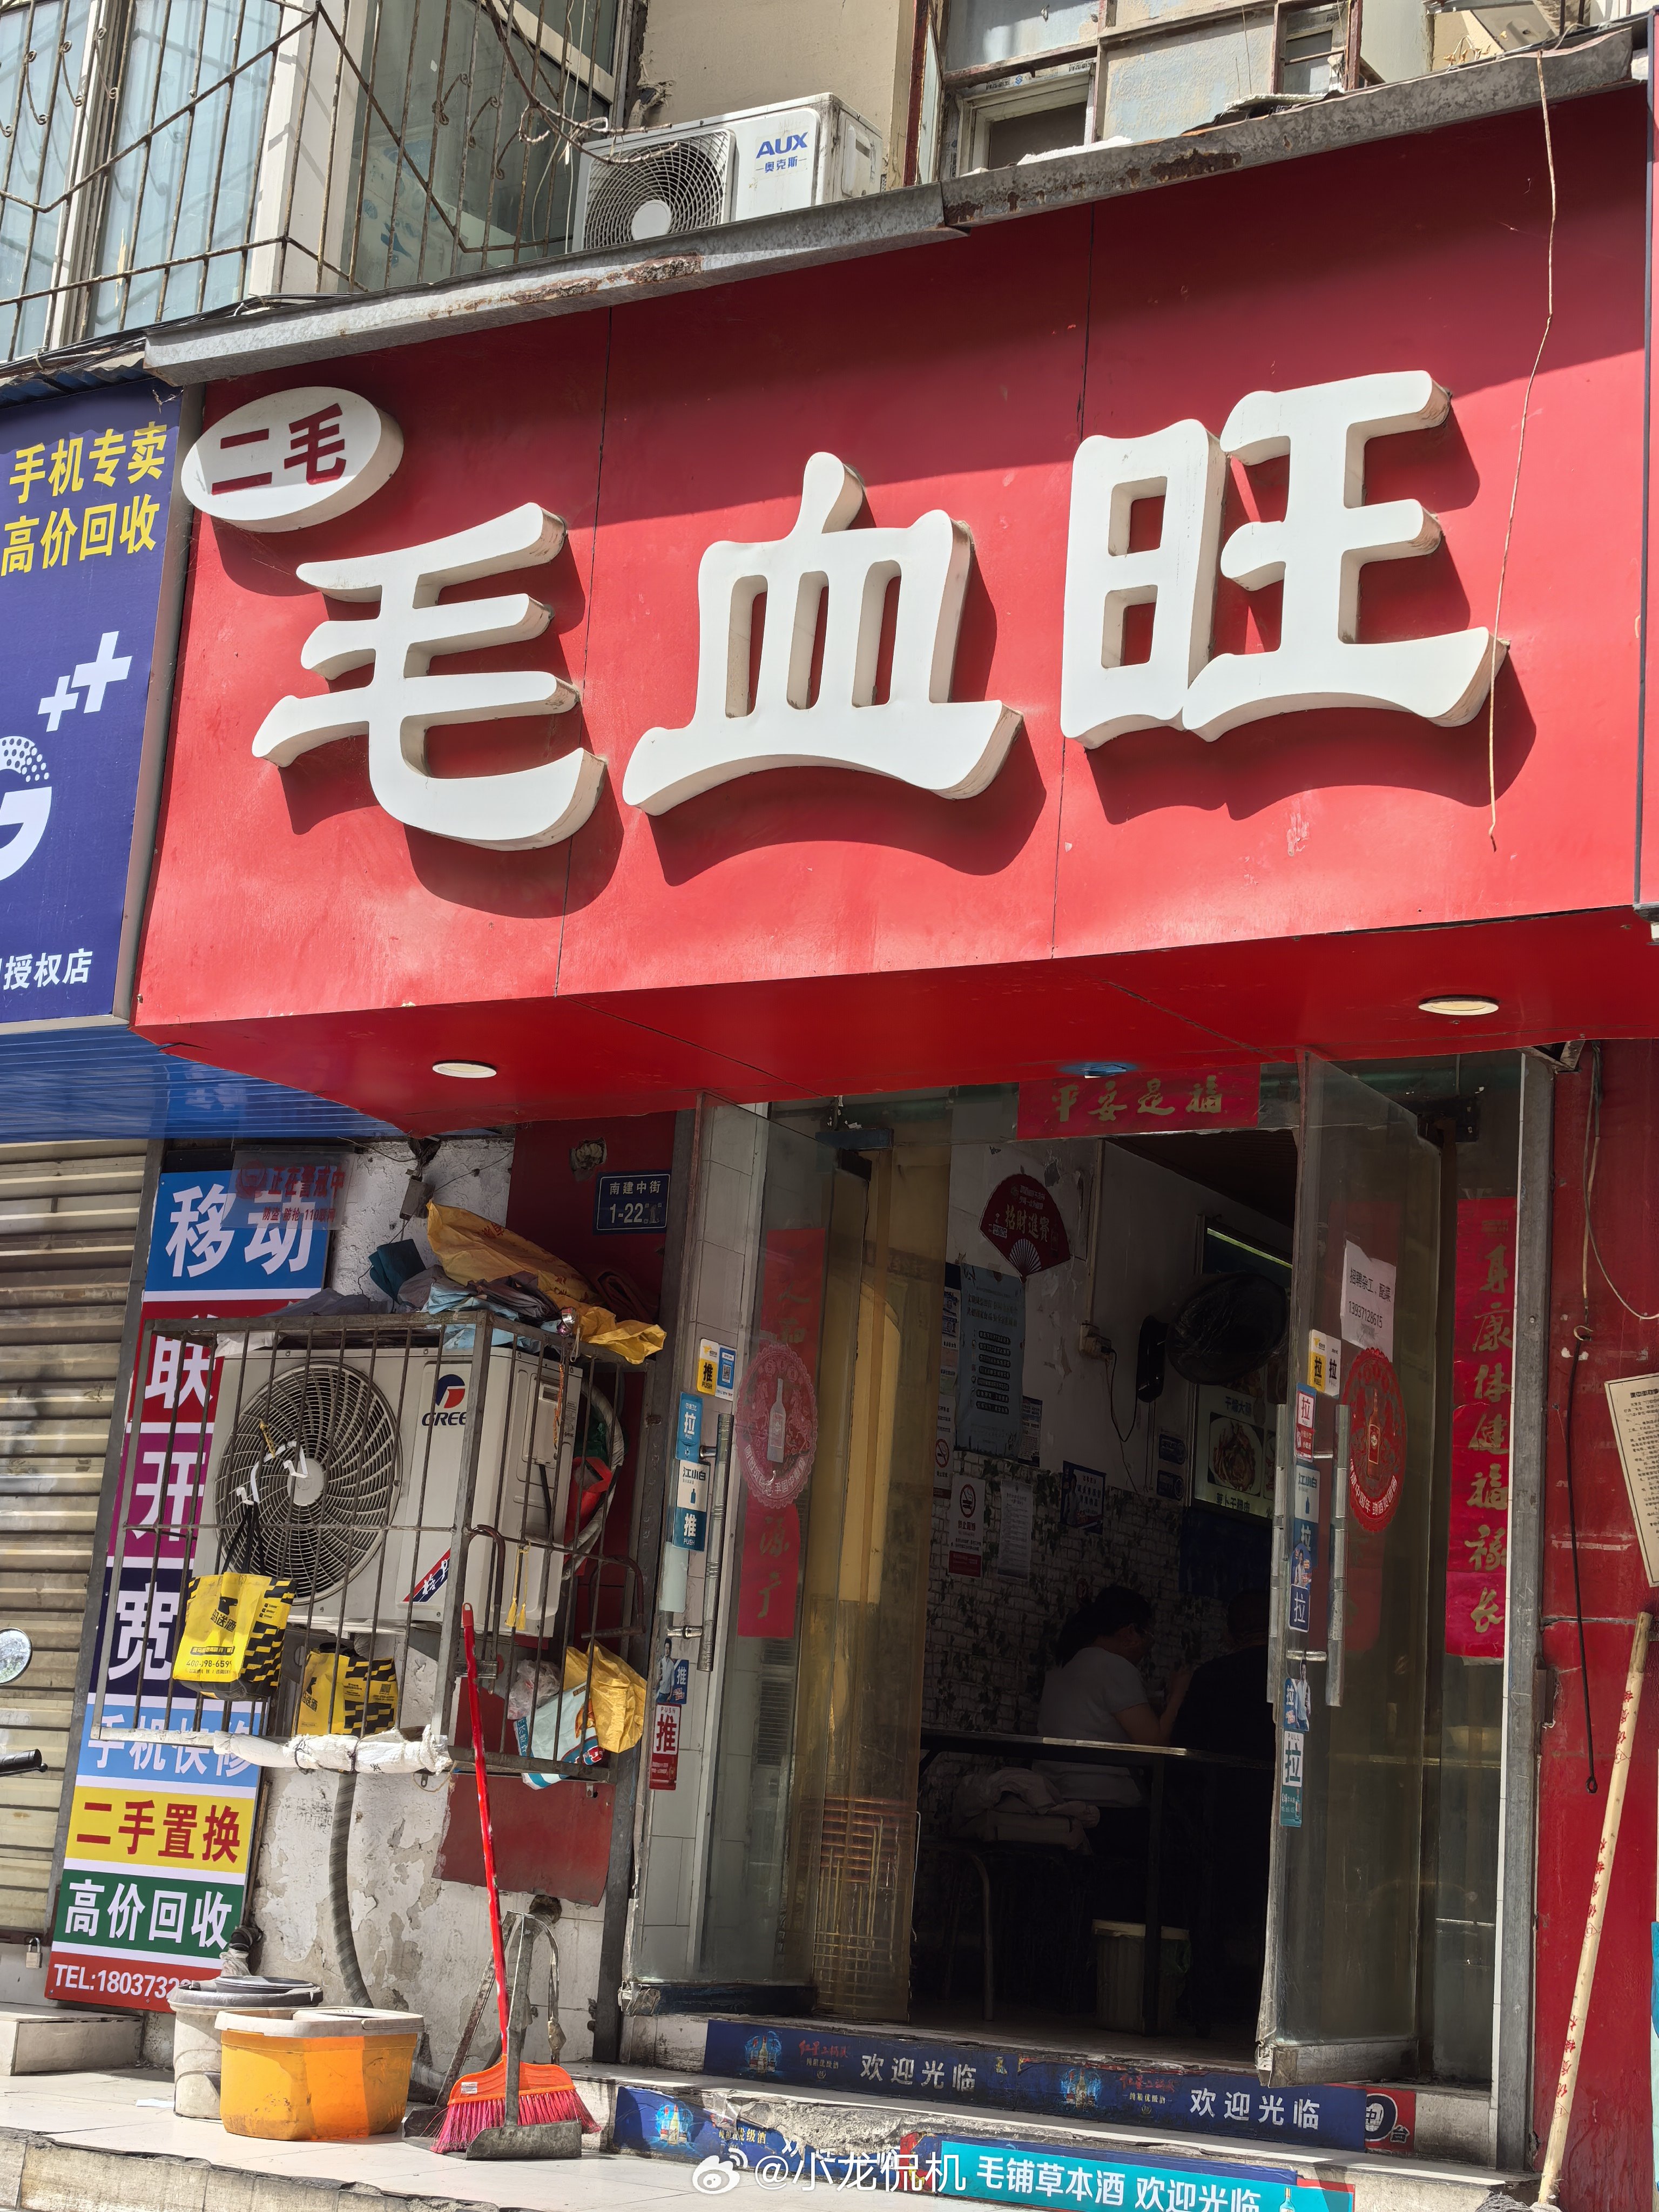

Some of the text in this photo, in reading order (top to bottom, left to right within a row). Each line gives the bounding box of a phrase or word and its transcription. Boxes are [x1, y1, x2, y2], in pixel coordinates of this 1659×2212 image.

[756, 132, 808, 159] AUX
[765, 156, 798, 173] 奥克斯
[211, 403, 347, 495] 二毛
[9, 421, 167, 504] 手机专卖
[1, 494, 160, 577] 高价回收
[252, 370, 1509, 851] 毛血旺
[0, 948, 93, 990] 授权店
[1052, 1074, 1222, 1123] 平安是福
[610, 1180, 661, 1196] 南建中街
[610, 1203, 644, 1224] 1-22
[165, 1183, 316, 1278] 移动
[703, 1362, 713, 1382] 推
[1314, 1356, 1322, 1378] 拉
[1329, 1358, 1337, 1380] 拉
[702, 1381, 712, 1390] PUSH
[421, 1411, 467, 1426] GREE
[1301, 1397, 1311, 1420] 拉
[684, 1412, 696, 1435] 拉
[683, 1466, 706, 1481] 江小白
[1298, 1472, 1318, 1489] 江小白
[683, 1513, 697, 1537] 推
[1293, 1591, 1306, 1623] 拉
[677, 1666, 687, 1685] 推
[1286, 1685, 1294, 1705] 拉
[656, 1714, 677, 1752] 推
[1288, 1732, 1300, 1741] PULL
[1285, 1741, 1301, 1783] 拉
[76, 1799, 241, 1864] 二手置换
[64, 1878, 233, 1950] 高价回收
[860, 2053, 977, 2092] 欢迎光临
[1190, 2088, 1321, 2131] 欢迎光临
[977, 2155, 1262, 2212] 毛铺草本酒 欢迎光临
